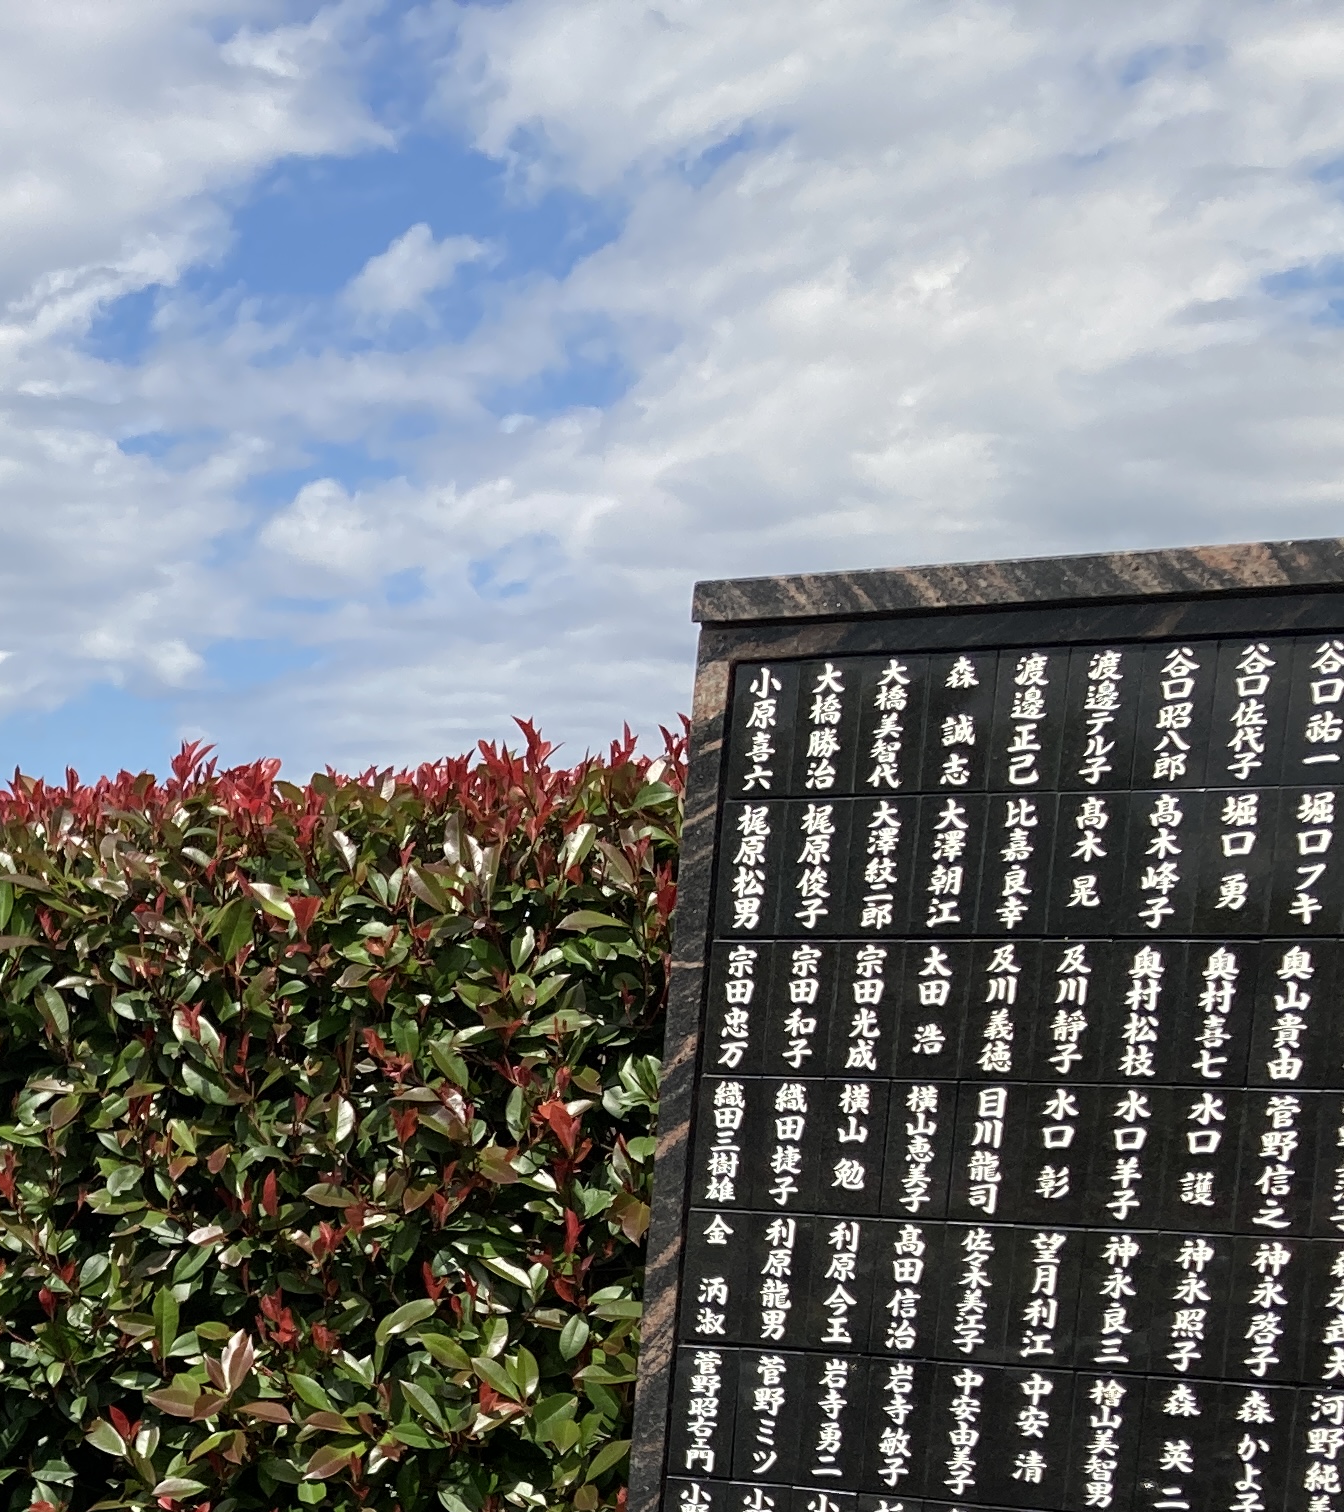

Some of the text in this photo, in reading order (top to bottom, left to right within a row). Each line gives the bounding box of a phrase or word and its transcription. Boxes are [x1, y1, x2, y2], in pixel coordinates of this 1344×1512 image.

[742, 667, 782, 791] 小原喜六
[805, 662, 845, 790] 大橋勝治
[866, 659, 911, 789] 大橋美智代
[1152, 646, 1201, 781] 谷口昭八郎
[1227, 643, 1277, 780] 谷口佐代子
[731, 804, 771, 930] 梶原松男
[794, 803, 836, 929] 梶原俊子
[860, 800, 902, 930] 大澤紋二郎
[925, 798, 969, 928] 大澤朝江
[995, 798, 1038, 929] 比嘉良幸
[1288, 791, 1336, 925] 堀口フキ
[717, 944, 758, 1068] 宗田忠万
[781, 944, 822, 1069] 宗田和子
[844, 944, 888, 1071] 宗田光成
[704, 1080, 746, 1203] 織田三樹雄
[768, 1082, 808, 1206] 織田捷子
[1105, 1090, 1152, 1220] 水口羊子
[1252, 1094, 1302, 1229] 菅野信之
[759, 1218, 796, 1341] 利原龍男
[952, 1227, 995, 1353] 佐々木美江子
[1019, 1232, 1067, 1358] 望月利江
[1093, 1234, 1140, 1363] 神永良三
[1166, 1238, 1215, 1372] 神永照子
[1243, 1242, 1292, 1377] 神永啓子
[752, 1355, 787, 1474] 菅野ミツ
[811, 1358, 848, 1476] 岩寺勇二
[877, 1362, 914, 1487] 岩寺敏子
[943, 1368, 984, 1495] 中安由美子
